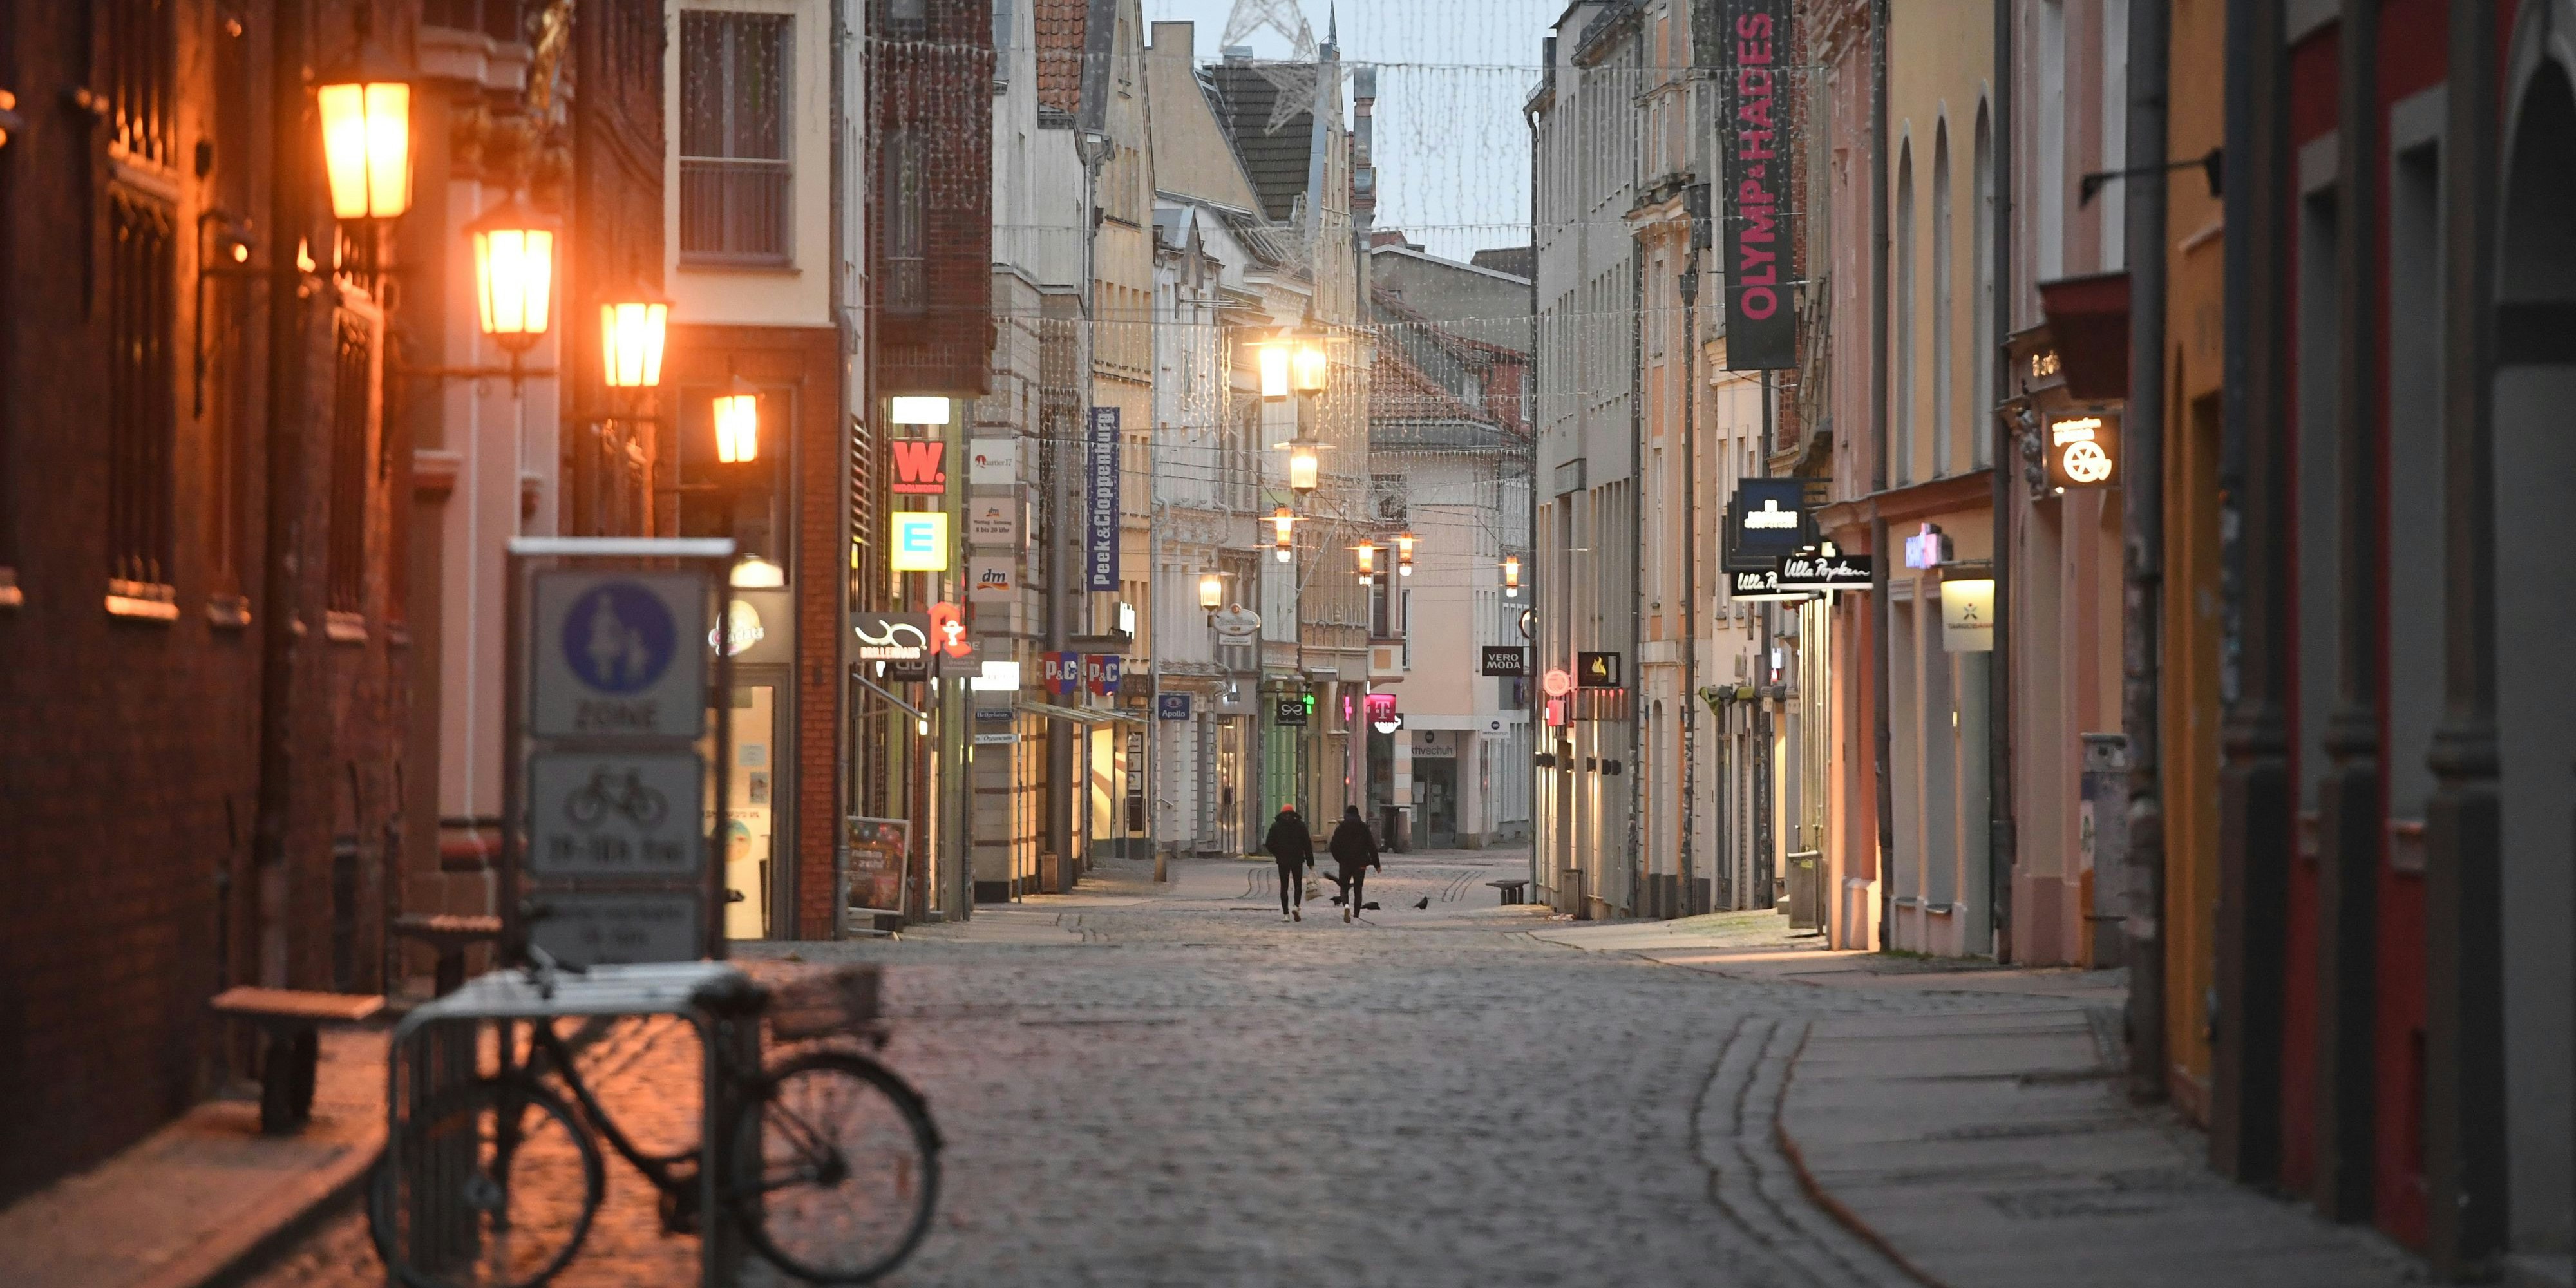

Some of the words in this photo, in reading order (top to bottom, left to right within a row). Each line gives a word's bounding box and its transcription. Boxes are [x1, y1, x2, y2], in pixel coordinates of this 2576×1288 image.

[1736, 12, 1777, 321] OLYMP&HADES
[893, 484, 945, 494] WOOLWORTH
[904, 523, 933, 551] E
[982, 569, 1006, 582] dm
[1784, 558, 1814, 578] Ulla
[1815, 558, 1870, 582] Popken
[1738, 572, 1765, 590] Ulla
[1045, 660, 1077, 681] P&C
[1089, 663, 1117, 682] P&C
[577, 700, 657, 730] ZONE
[1162, 710, 1186, 718] Apollo
